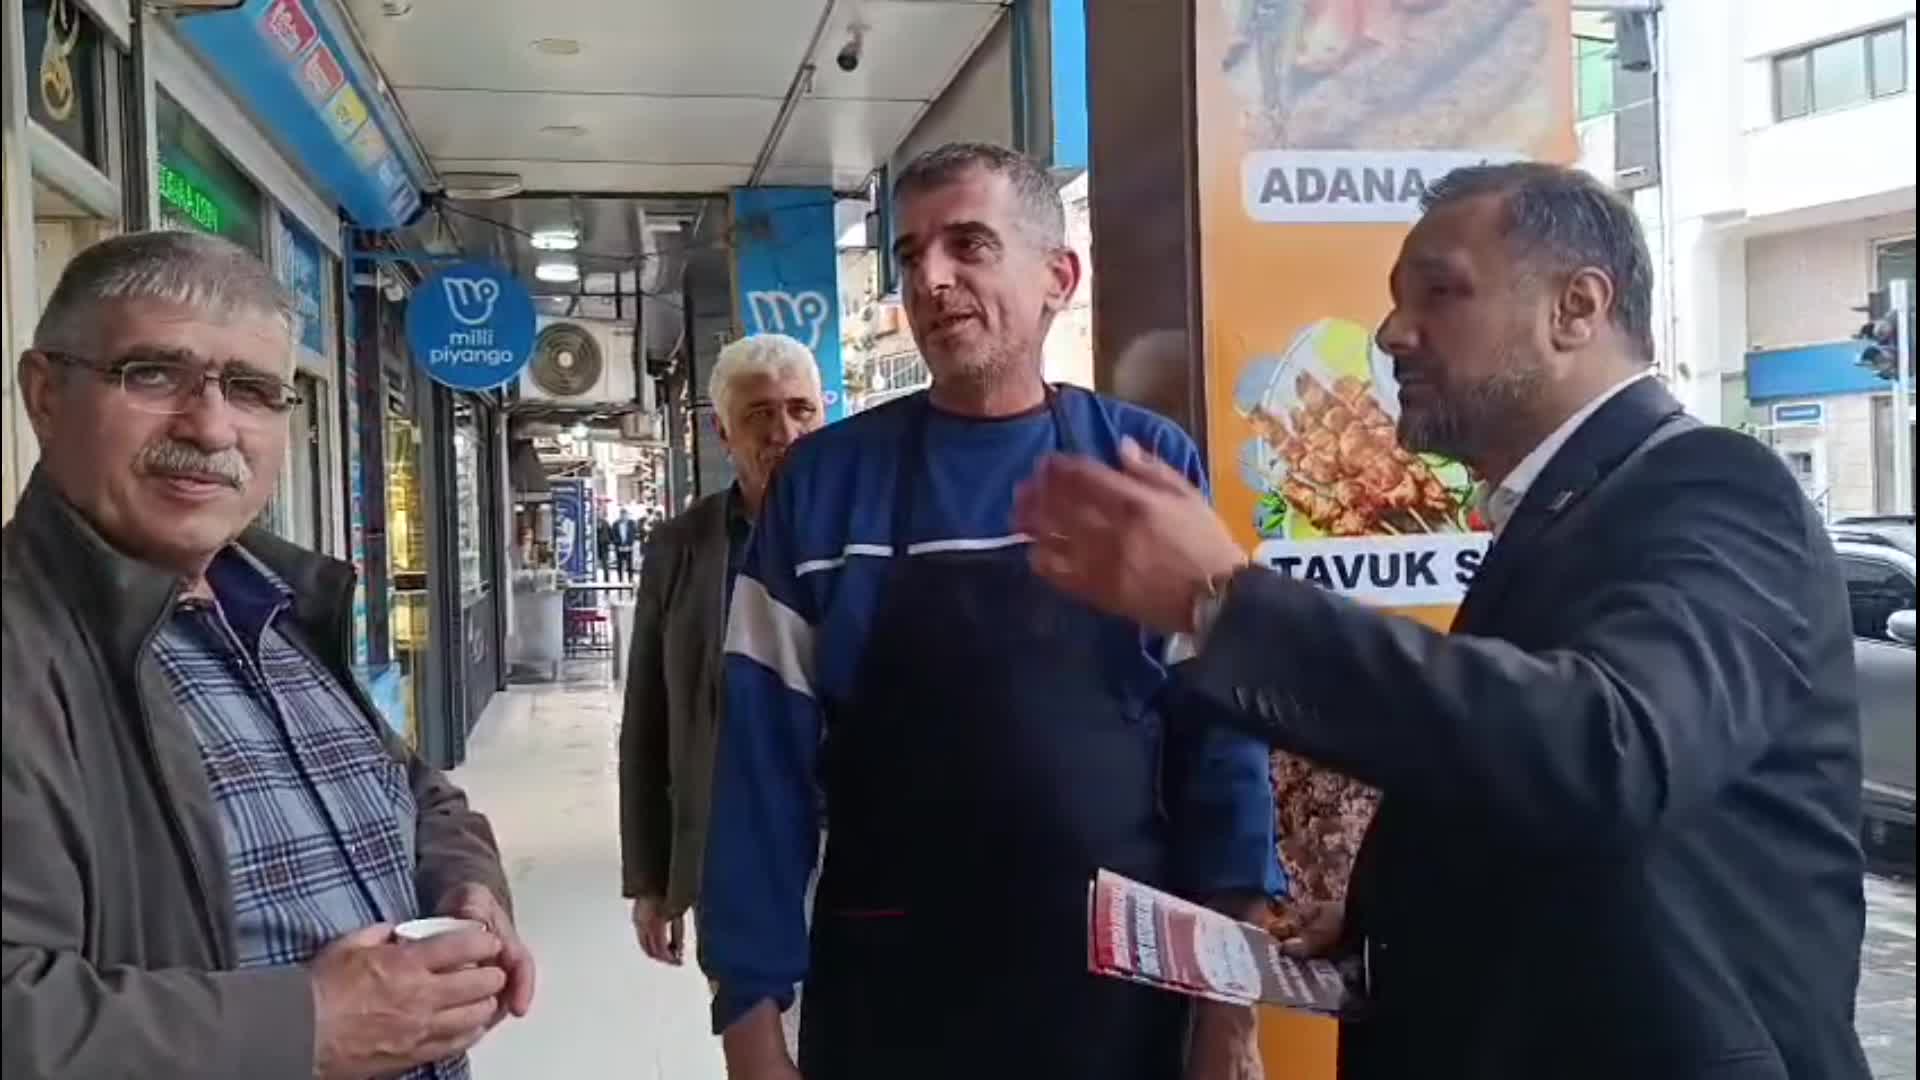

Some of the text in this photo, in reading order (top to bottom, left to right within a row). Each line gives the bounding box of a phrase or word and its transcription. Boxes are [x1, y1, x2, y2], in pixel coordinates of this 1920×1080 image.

[1259, 167, 1427, 204] ADANA
[449, 329, 494, 346] milli
[429, 345, 514, 367] piyango
[1271, 550, 1440, 590] TAVUK
